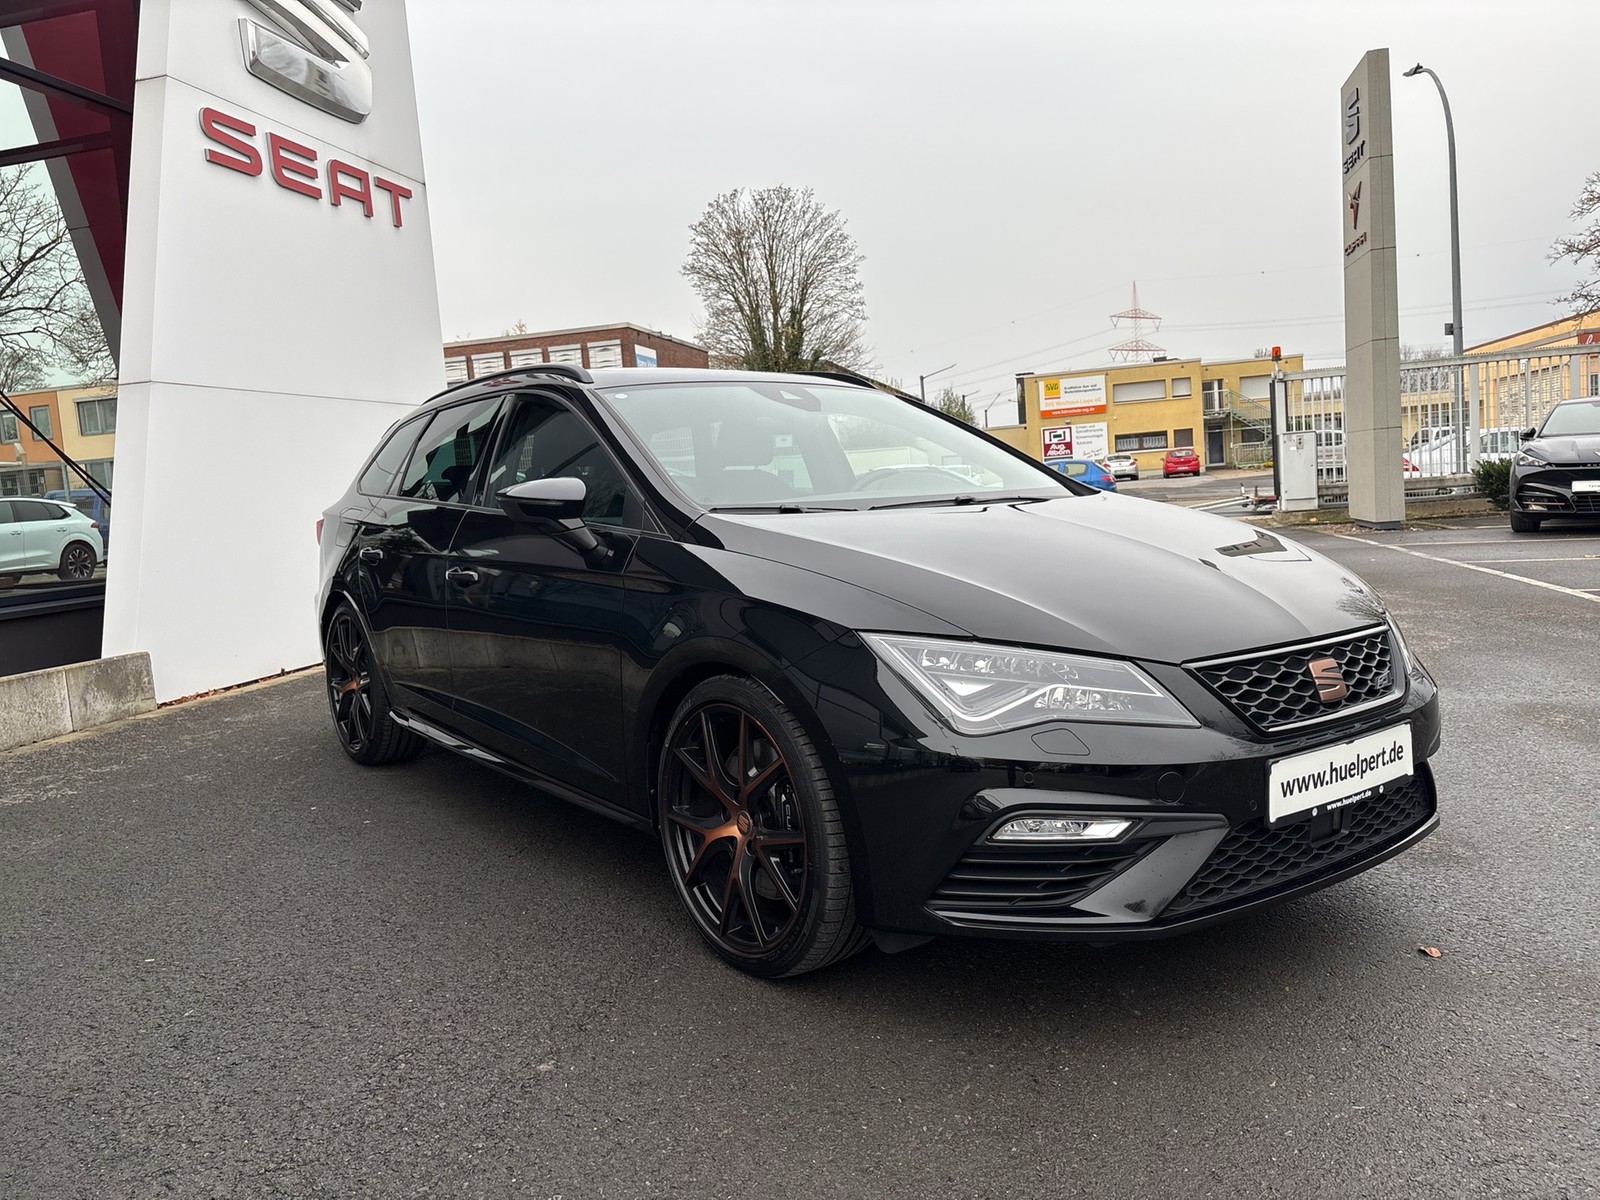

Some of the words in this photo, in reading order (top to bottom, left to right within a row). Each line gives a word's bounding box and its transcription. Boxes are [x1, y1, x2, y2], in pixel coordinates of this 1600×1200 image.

[199, 107, 413, 228] SEAT
[1343, 140, 1366, 175] SEAT
[1045, 383, 1059, 391] SVG
[1280, 741, 1404, 798] www.huelpert.de
[1326, 790, 1372, 811] www.huelpert.de
